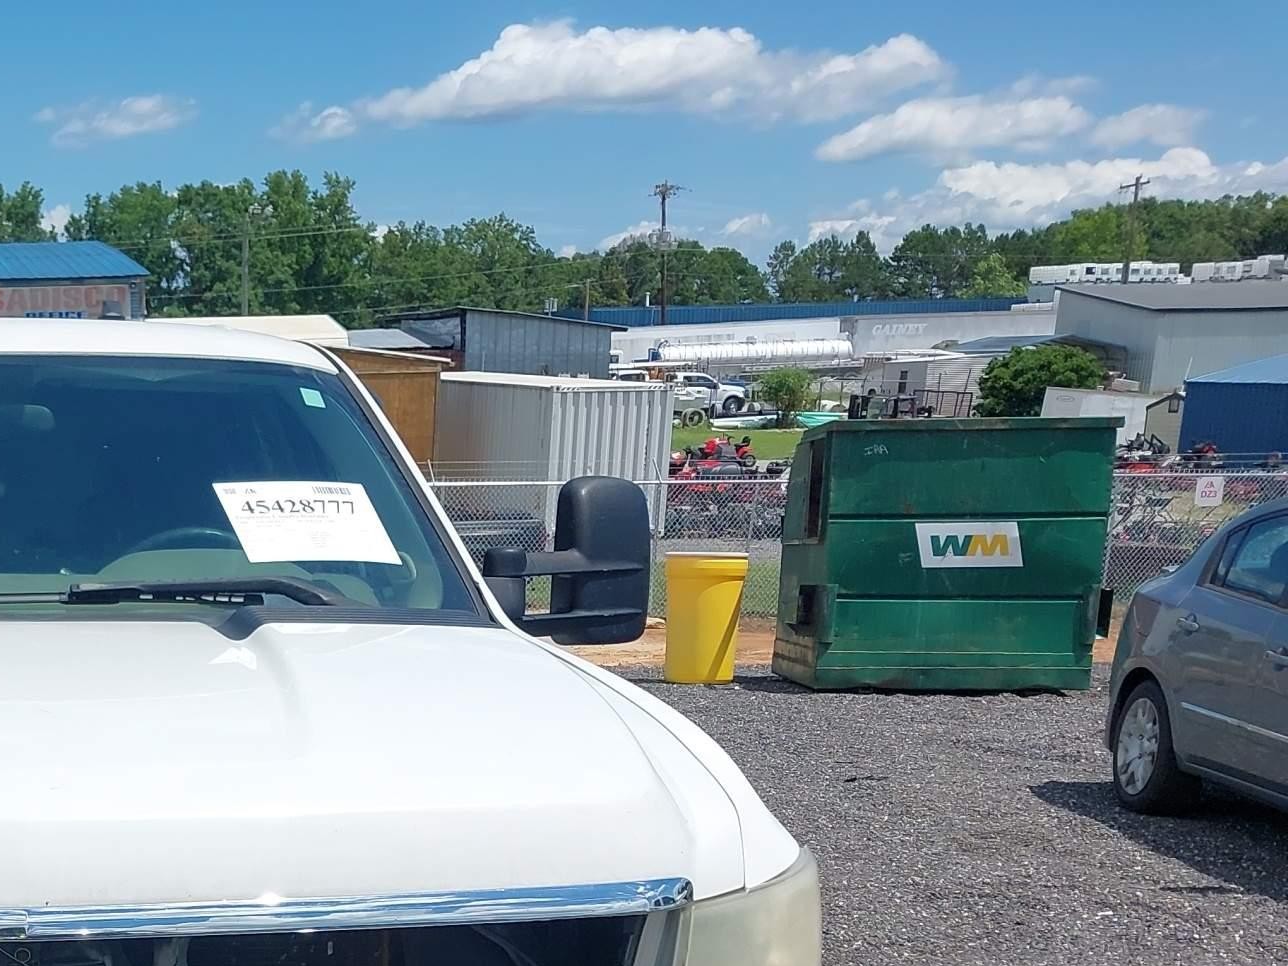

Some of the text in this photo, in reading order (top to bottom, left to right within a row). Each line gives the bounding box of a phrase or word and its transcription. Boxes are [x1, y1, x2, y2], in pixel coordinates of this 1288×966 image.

[872, 323, 928, 336] GAINEY
[241, 499, 355, 515] 45428777
[930, 534, 1010, 557] WM
